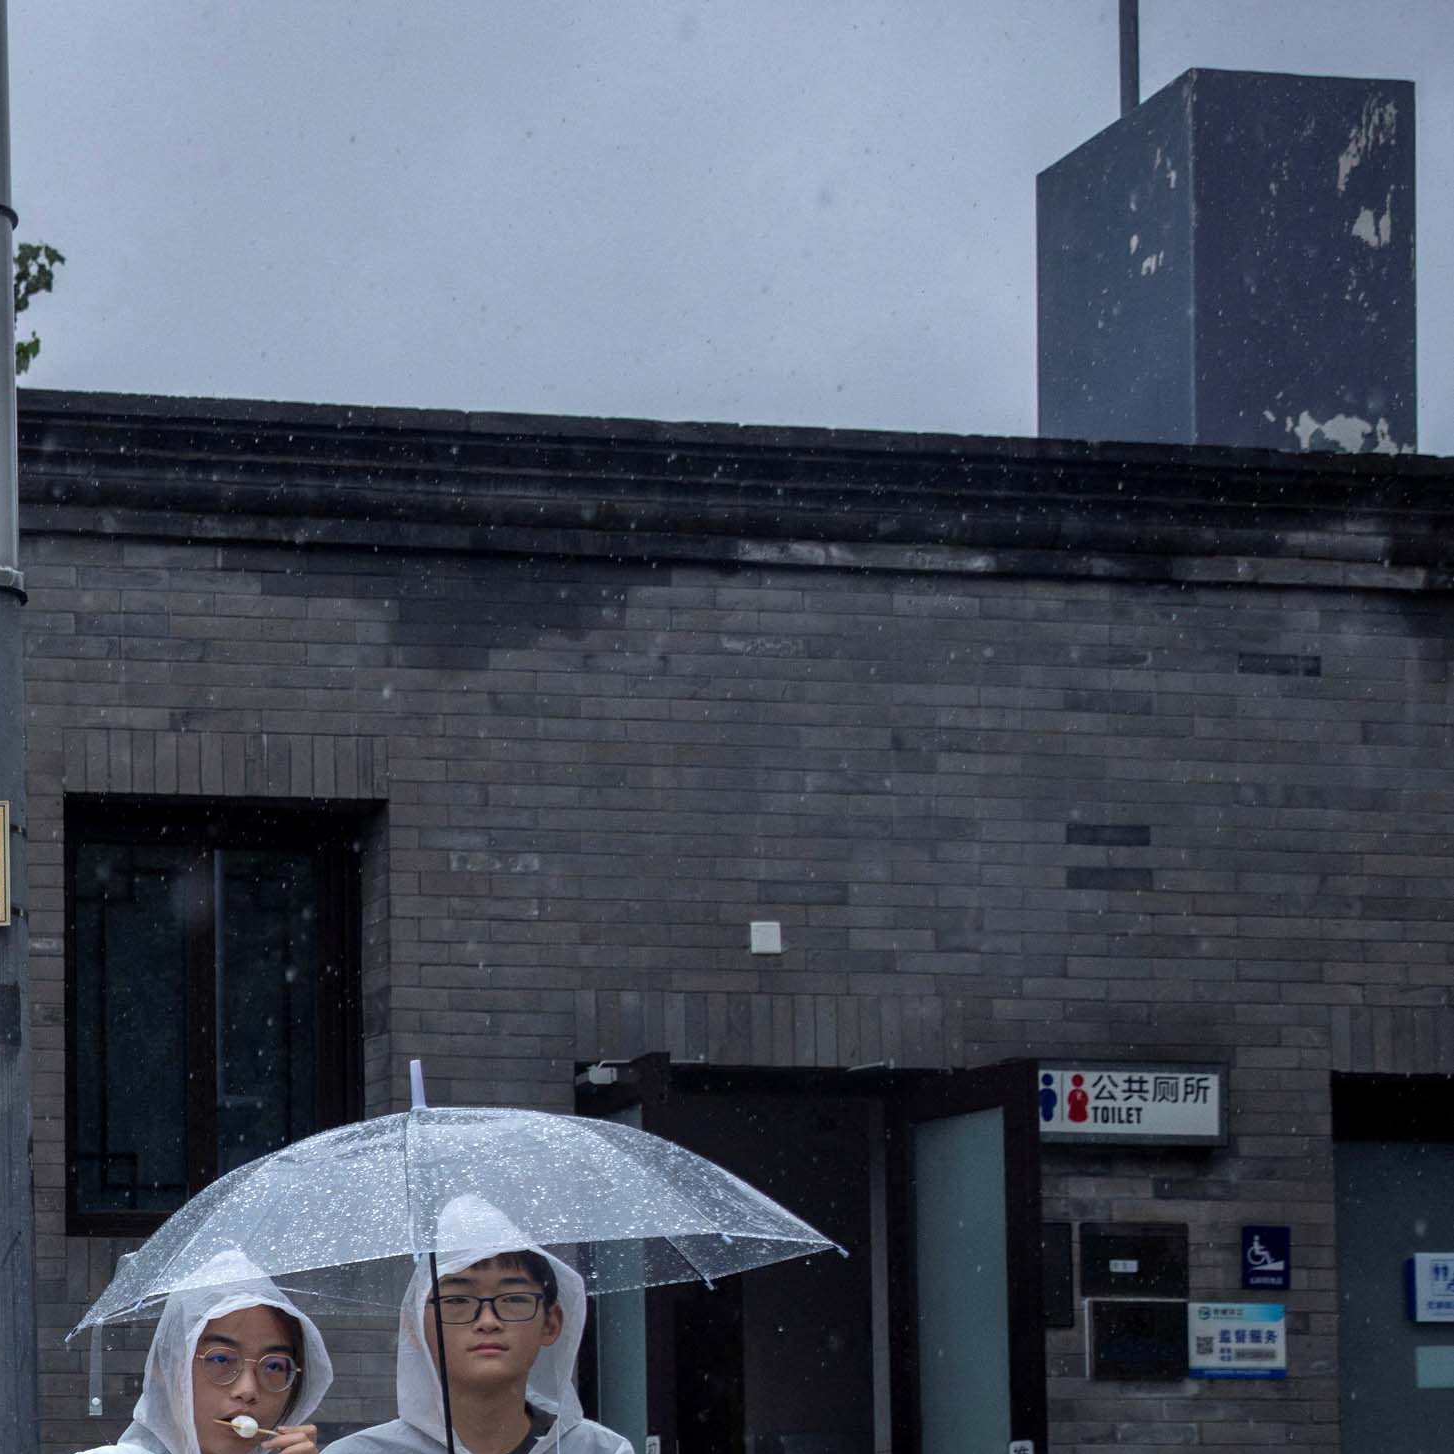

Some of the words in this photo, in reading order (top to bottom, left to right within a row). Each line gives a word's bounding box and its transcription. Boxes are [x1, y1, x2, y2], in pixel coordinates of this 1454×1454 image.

[1092, 1074, 1211, 1104] 公共厕所
[1092, 1106, 1143, 1124] TOILET
